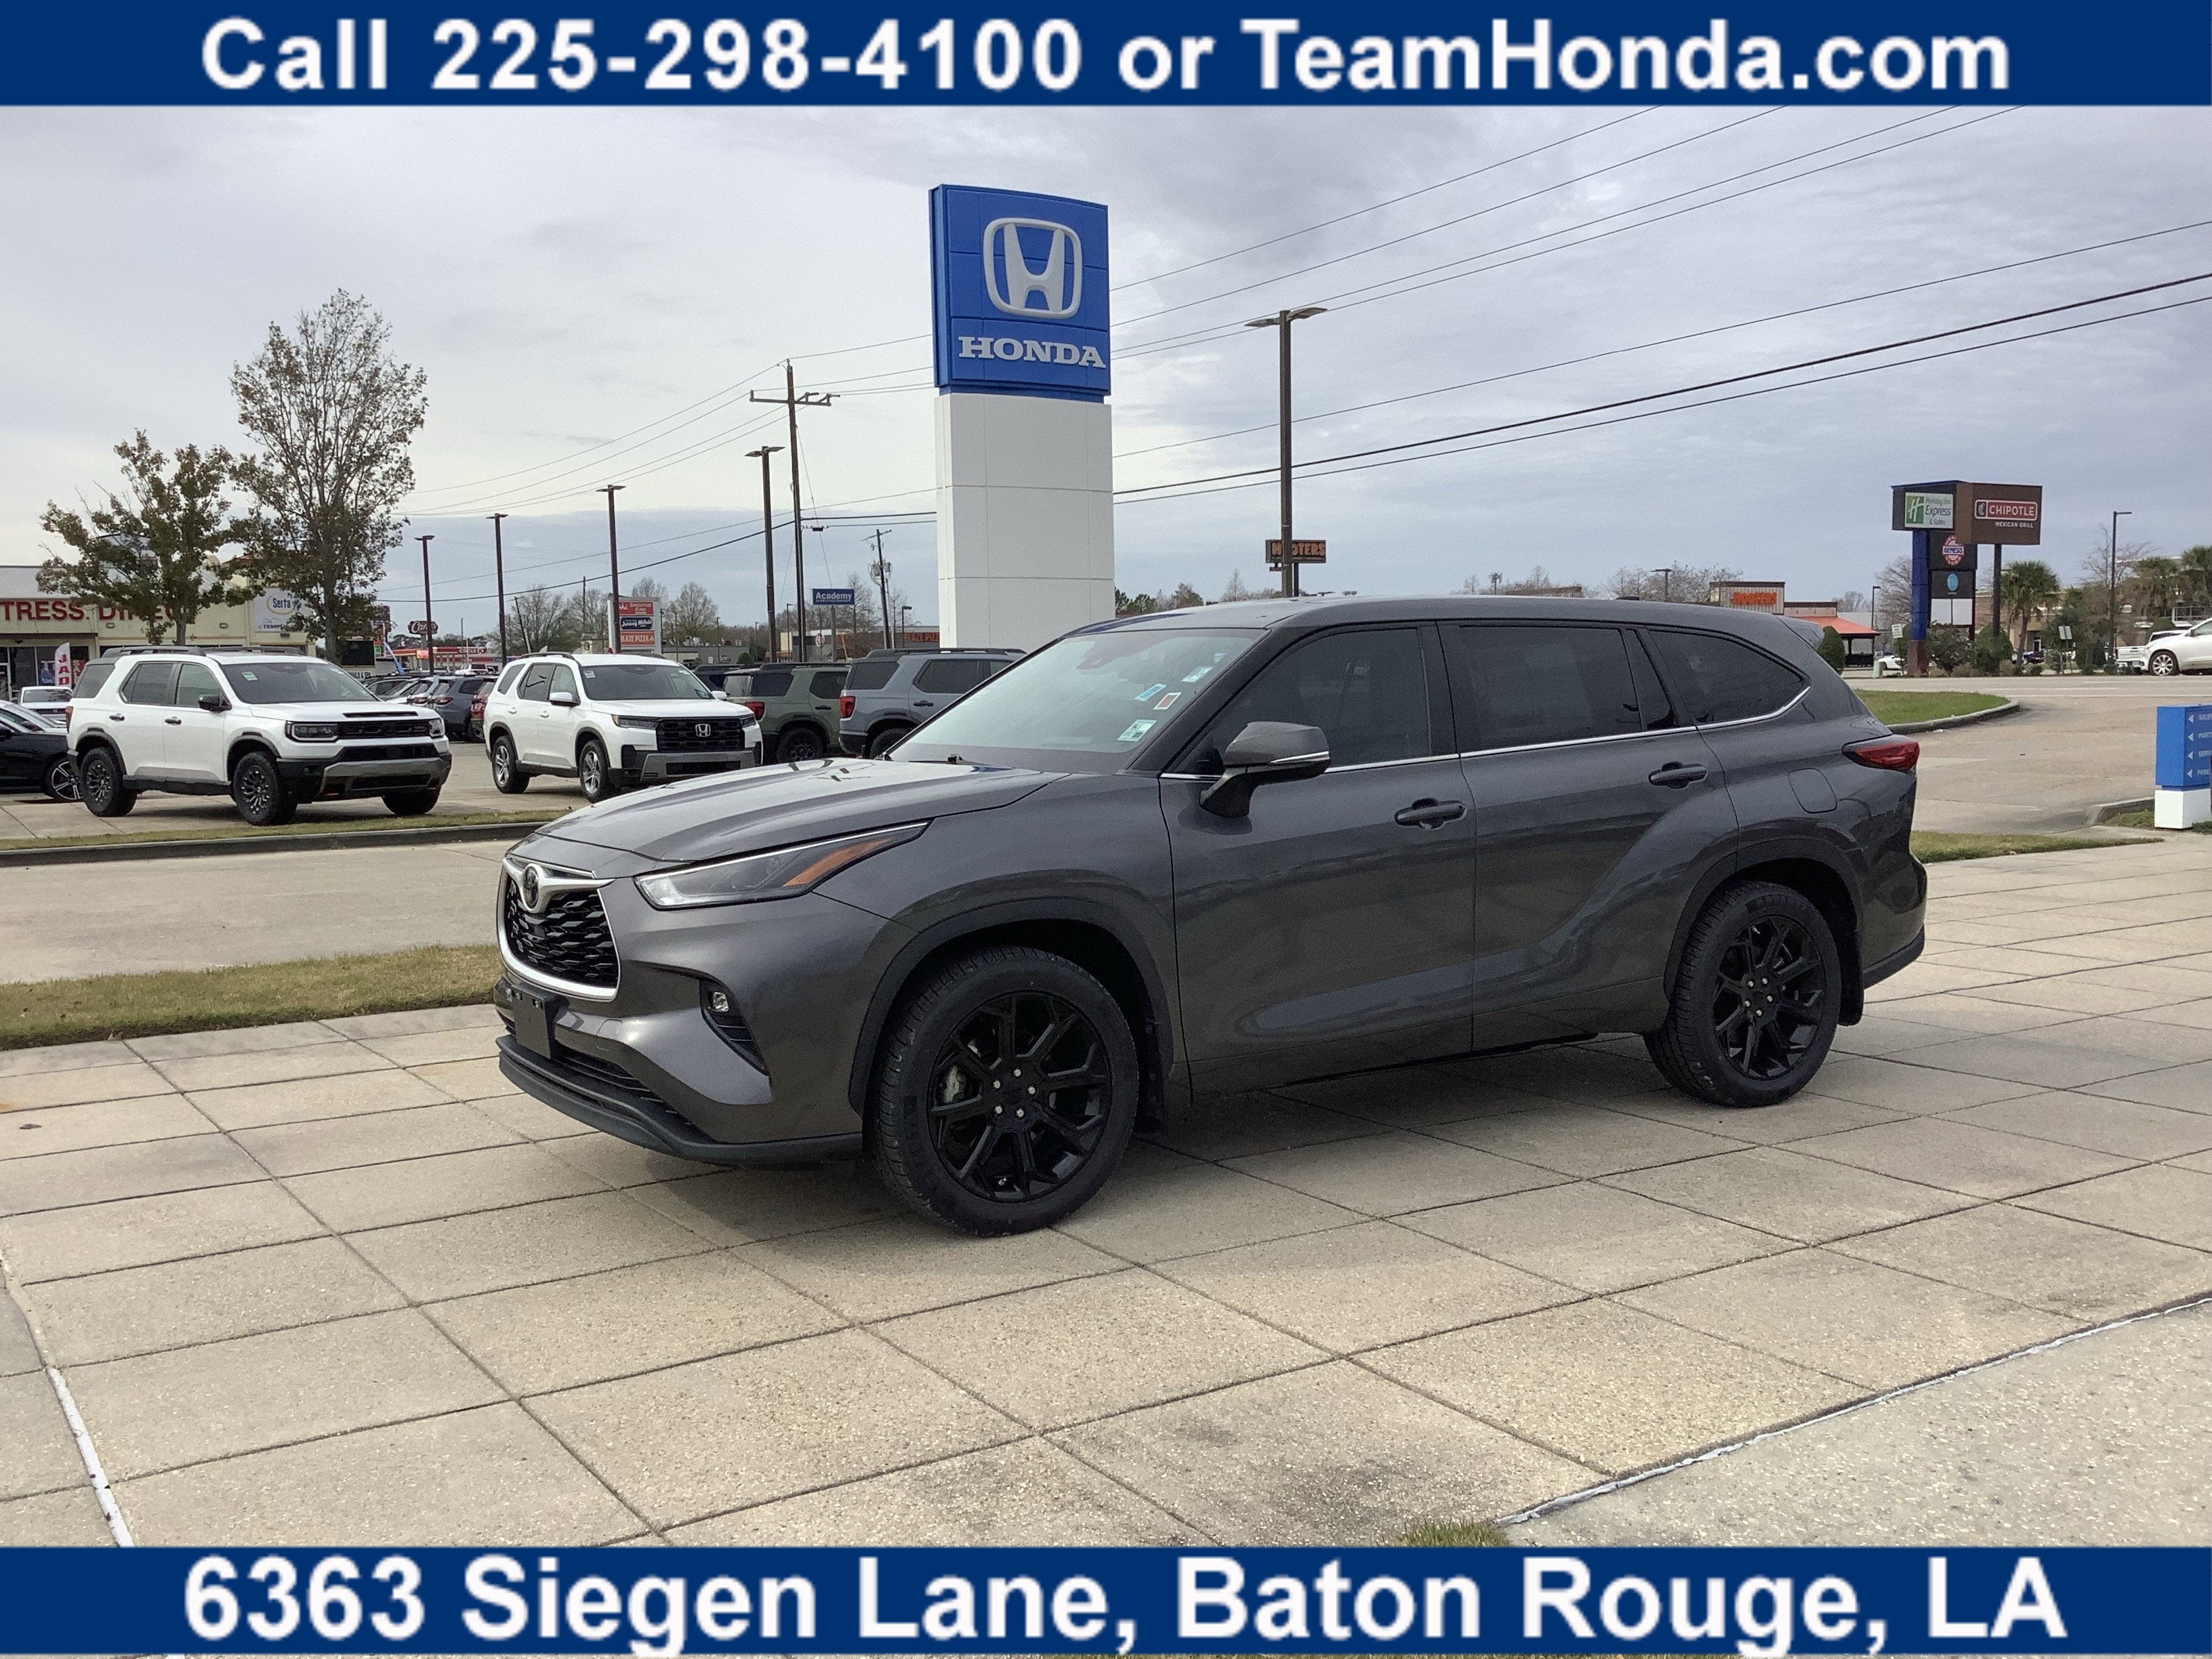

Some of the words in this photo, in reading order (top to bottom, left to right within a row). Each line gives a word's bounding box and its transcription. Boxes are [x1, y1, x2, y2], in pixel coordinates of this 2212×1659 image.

[958, 336, 1107, 369] HONDA
[1925, 505, 1951, 518] Express
[1989, 505, 2035, 516] CHIPOTLE
[815, 592, 853, 602] Academy
[272, 598, 291, 609] Serta
